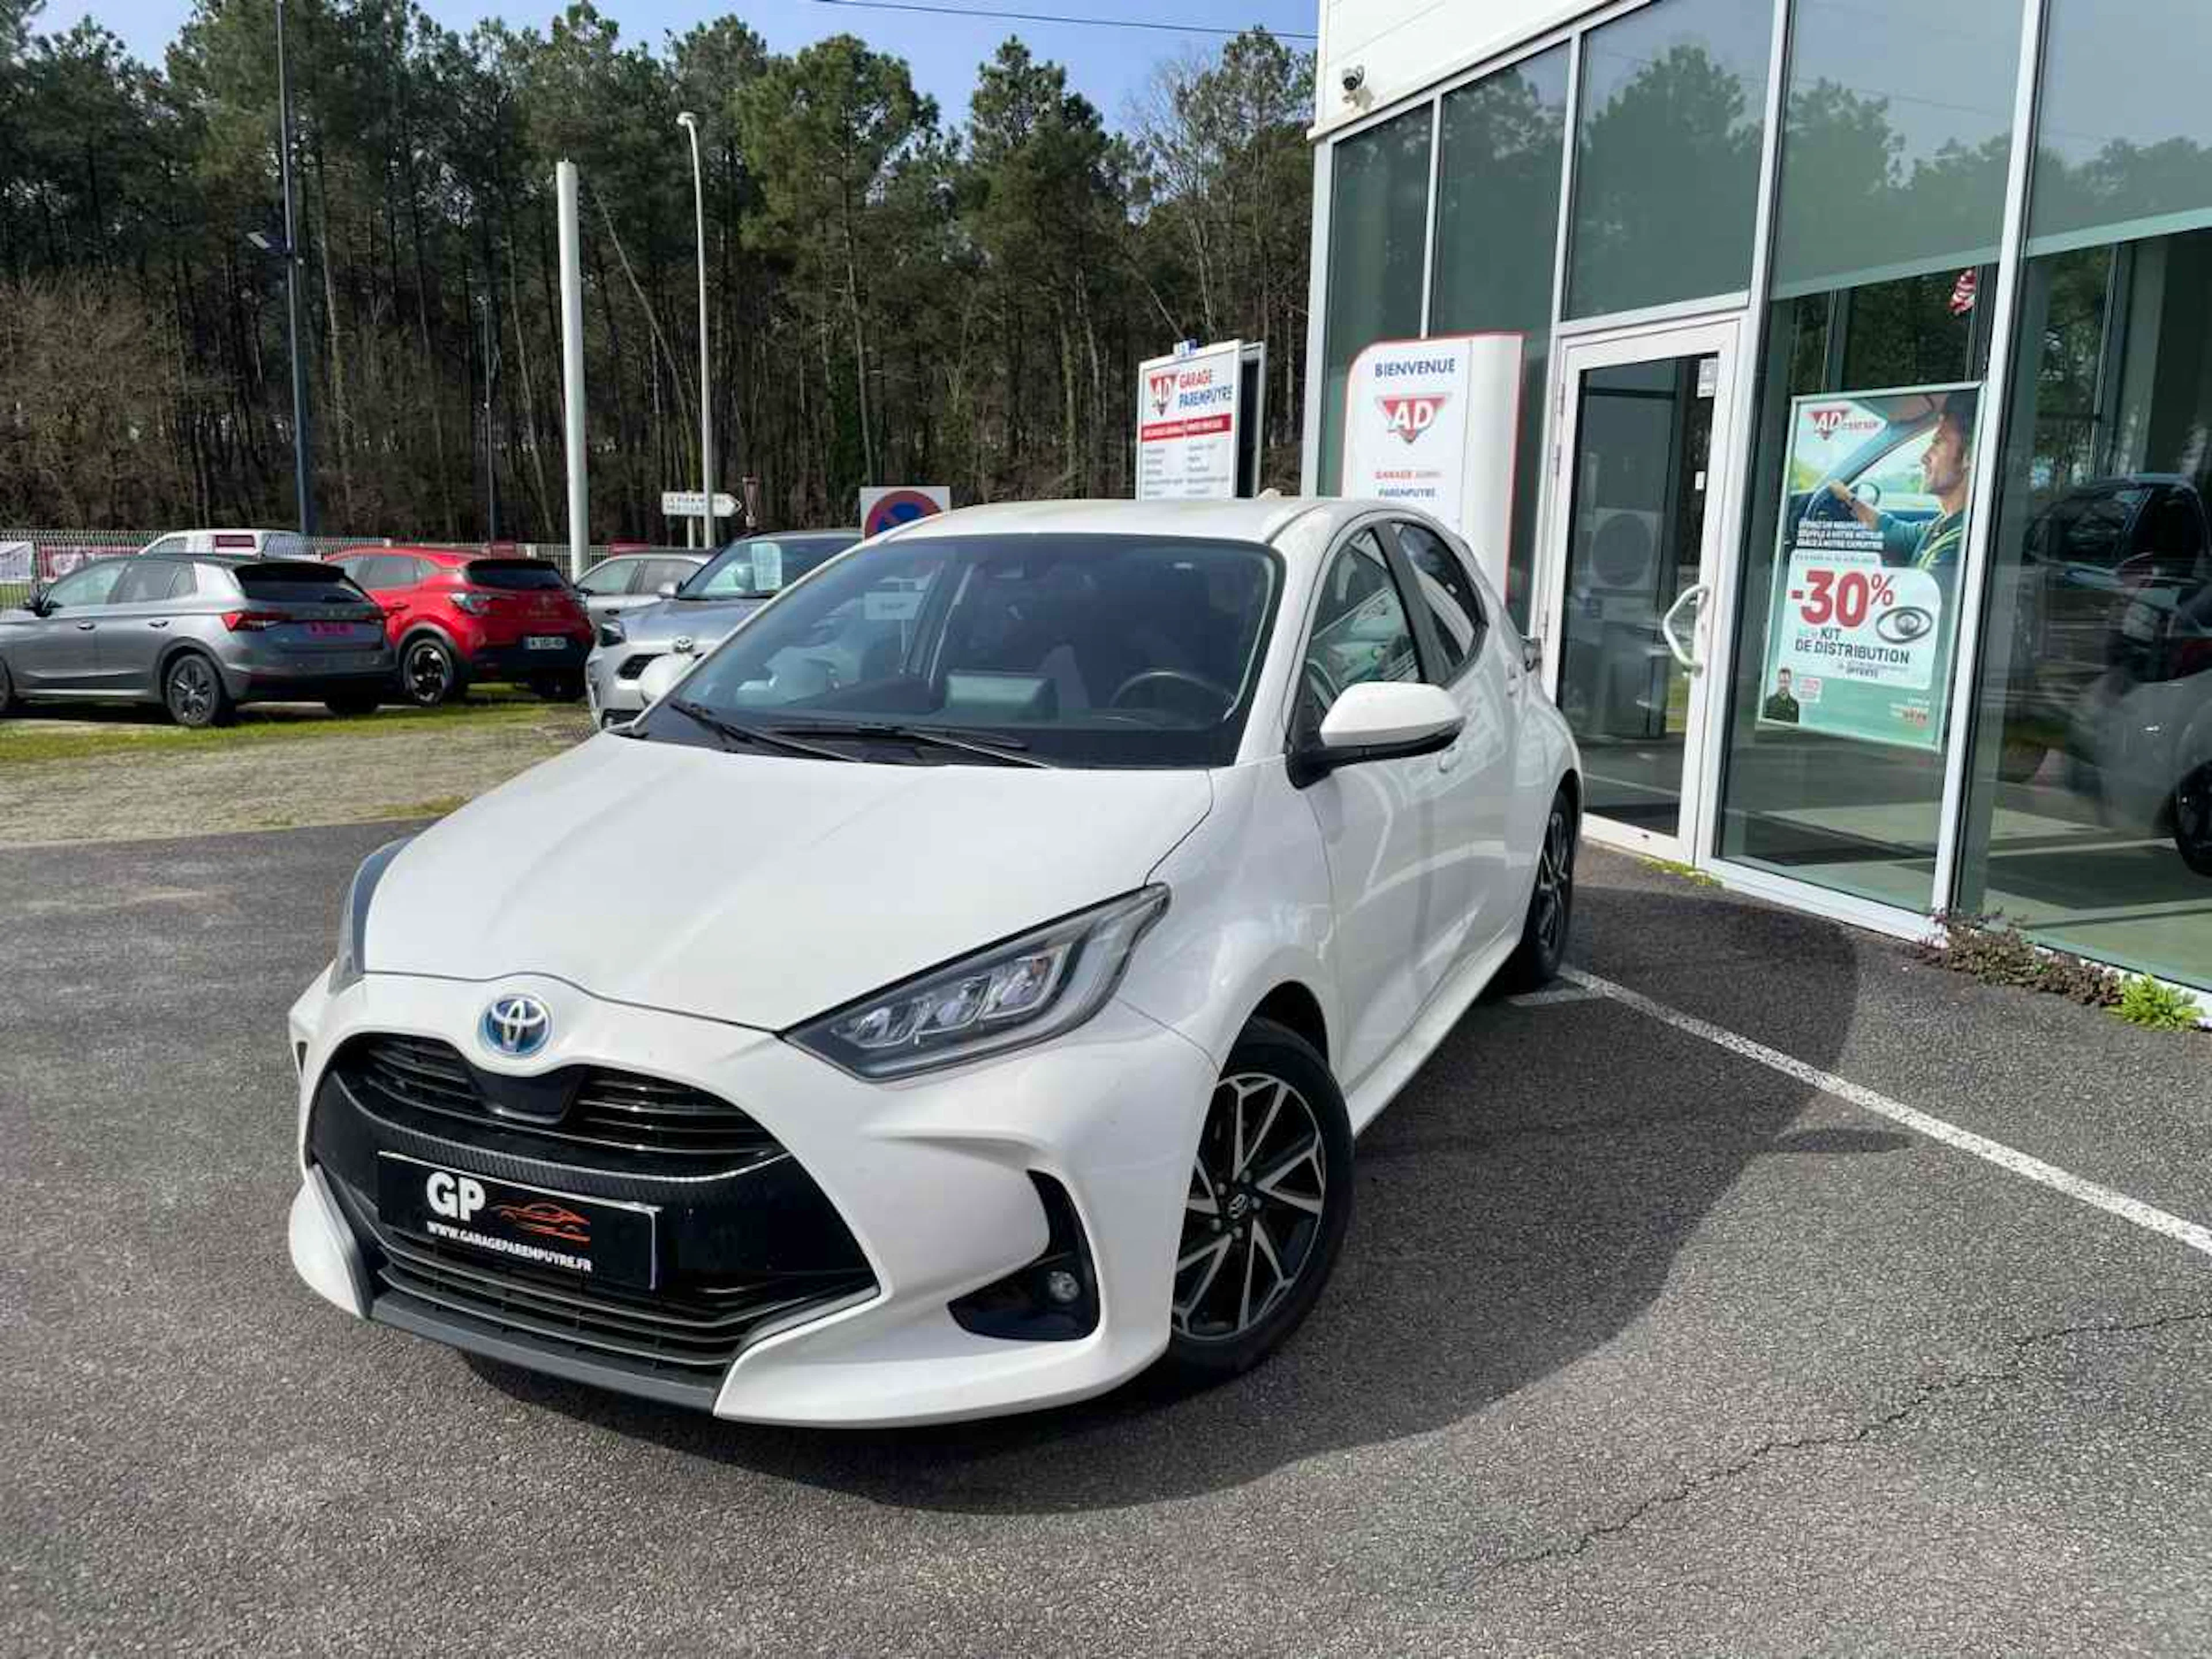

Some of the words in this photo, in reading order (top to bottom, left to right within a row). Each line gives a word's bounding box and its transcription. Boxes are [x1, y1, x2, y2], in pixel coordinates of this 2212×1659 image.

[1374, 358, 1456, 377] BIENVENUE
[1389, 400, 1434, 431] AD
[1791, 570, 1894, 628] -30%
[1821, 627, 1842, 641] KIT
[1795, 639, 1812, 653] DE
[1814, 641, 1910, 664] DISTRIBUTION
[426, 1171, 486, 1221] GP
[426, 1221, 592, 1272] WWW.GARAGEPAREMPUYRE.FR
